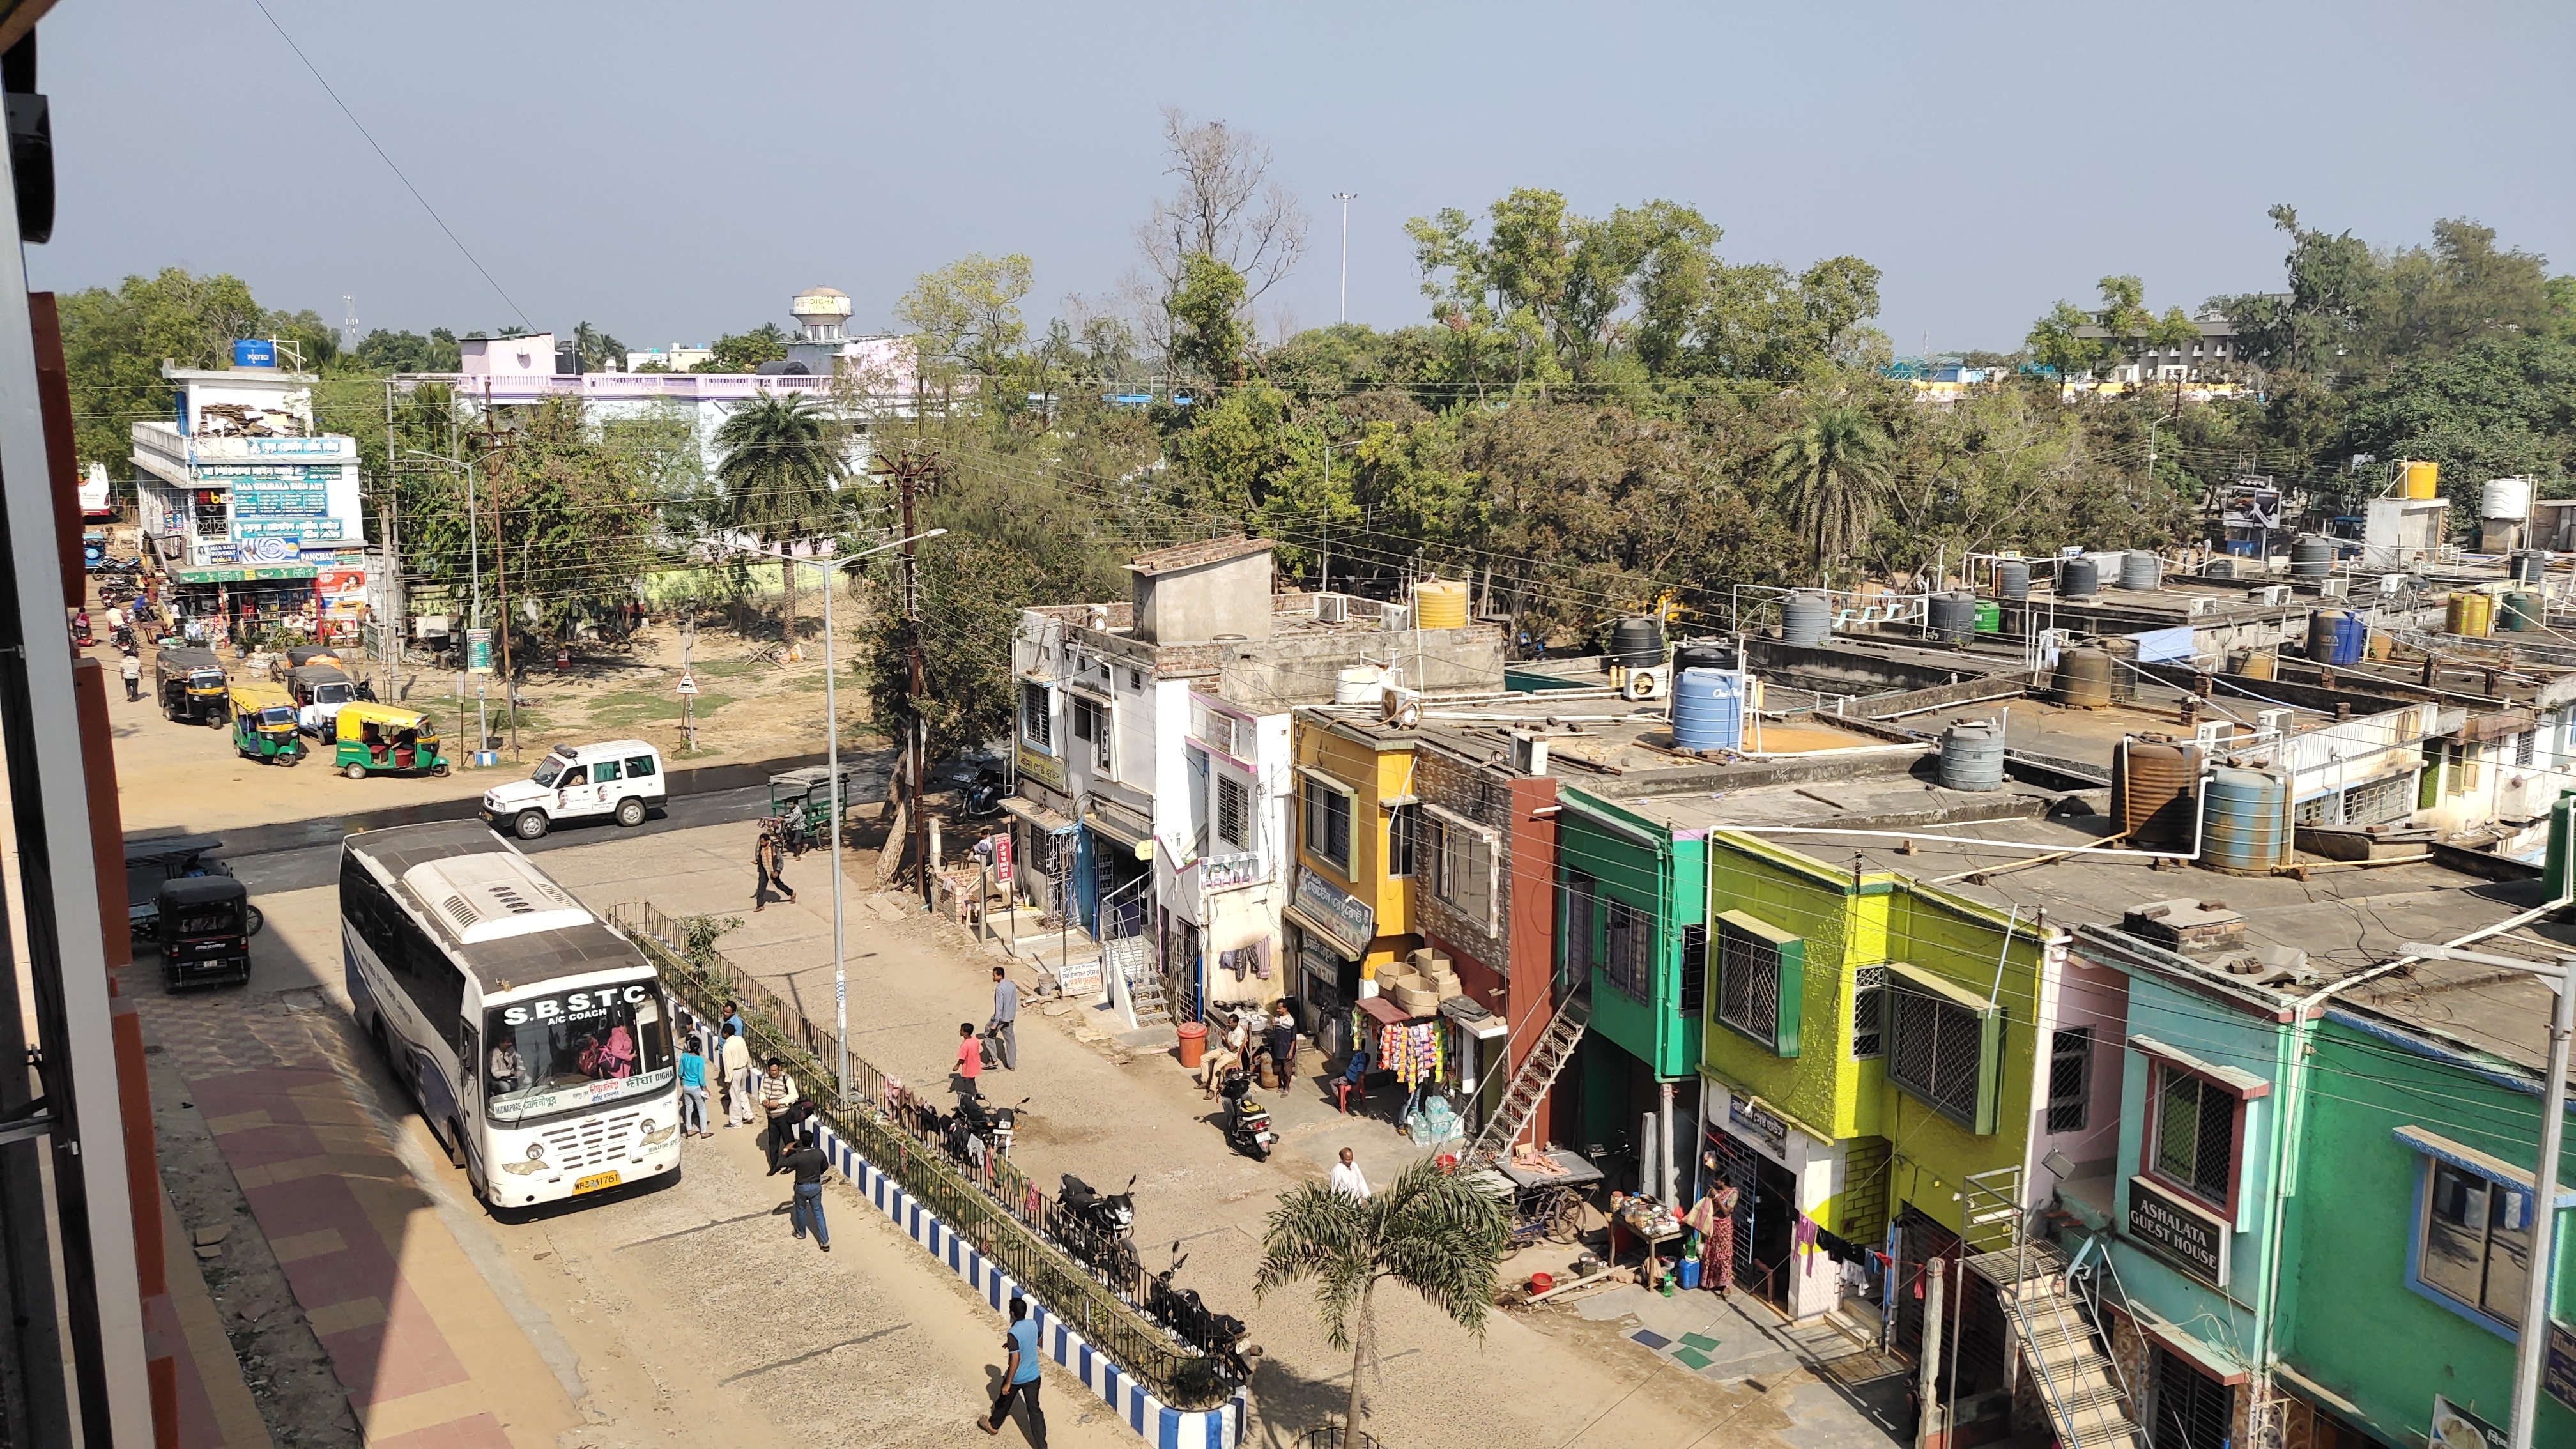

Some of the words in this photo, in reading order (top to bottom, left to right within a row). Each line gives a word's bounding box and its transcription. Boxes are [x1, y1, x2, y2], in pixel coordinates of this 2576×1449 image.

[236, 482, 253, 491] MAA
[254, 482, 289, 491] GIRIBALA
[290, 482, 309, 491] SIGN
[309, 482, 325, 491] ART
[301, 552, 335, 561] PANCHAT
[548, 1016, 566, 1026] A/C
[569, 1008, 607, 1022] COACH
[626, 1075, 652, 1088] দীঘা
[656, 1069, 673, 1082] DIGHA
[495, 1102, 521, 1115] MIDNAPORE
[2140, 1199, 2207, 1248] ASHALATA
[2130, 1209, 2170, 1242] GUEST
[2174, 1234, 2217, 1269] HOUSE
